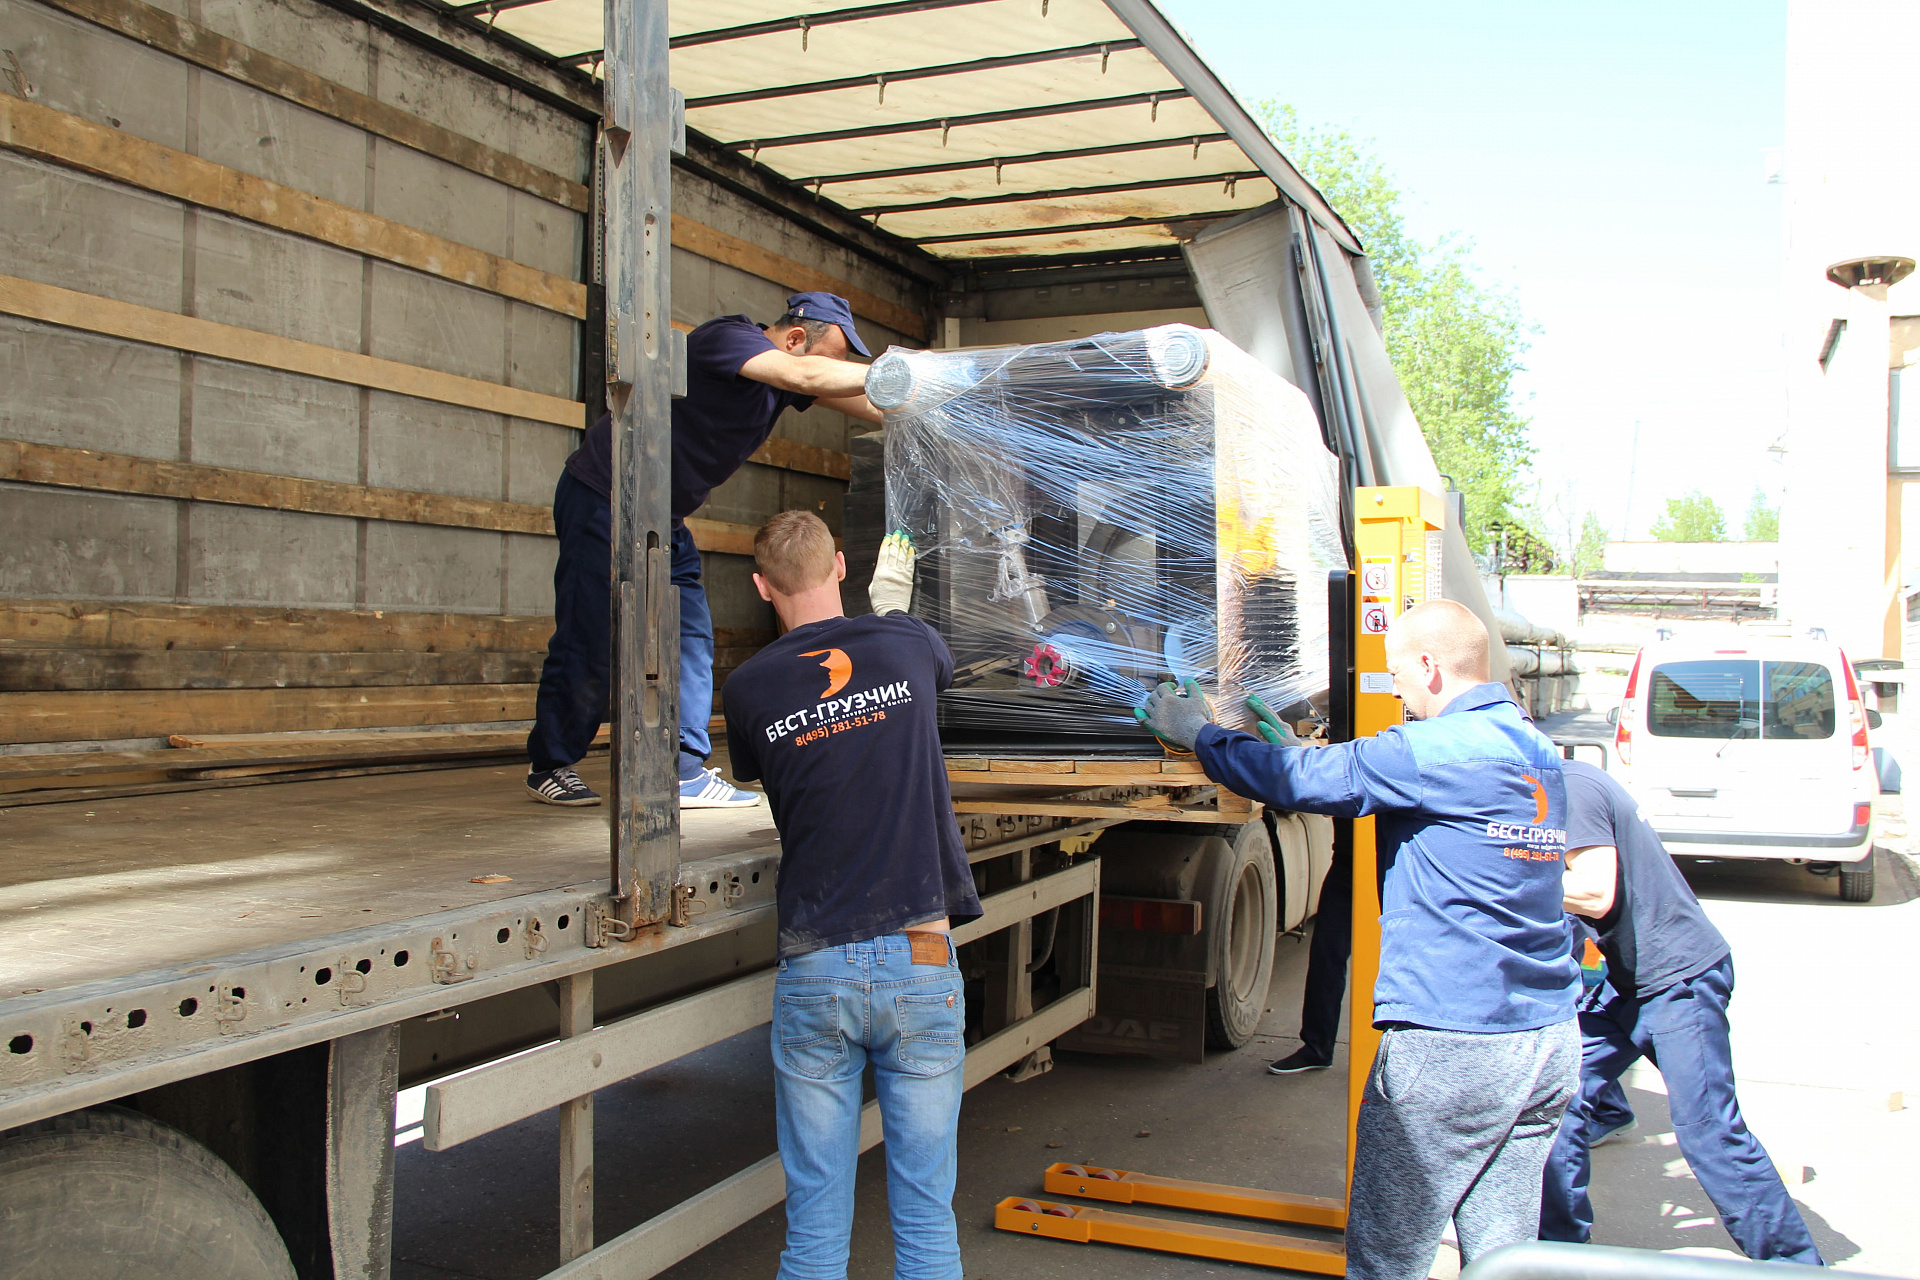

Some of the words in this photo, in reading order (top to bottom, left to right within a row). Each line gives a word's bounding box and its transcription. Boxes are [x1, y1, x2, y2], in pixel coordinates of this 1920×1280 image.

[765, 680, 912, 743] БЕСТ-ГРУЗЧИК
[831, 710, 886, 734] 281-51-78
[1081, 1015, 1180, 1041] DAF
